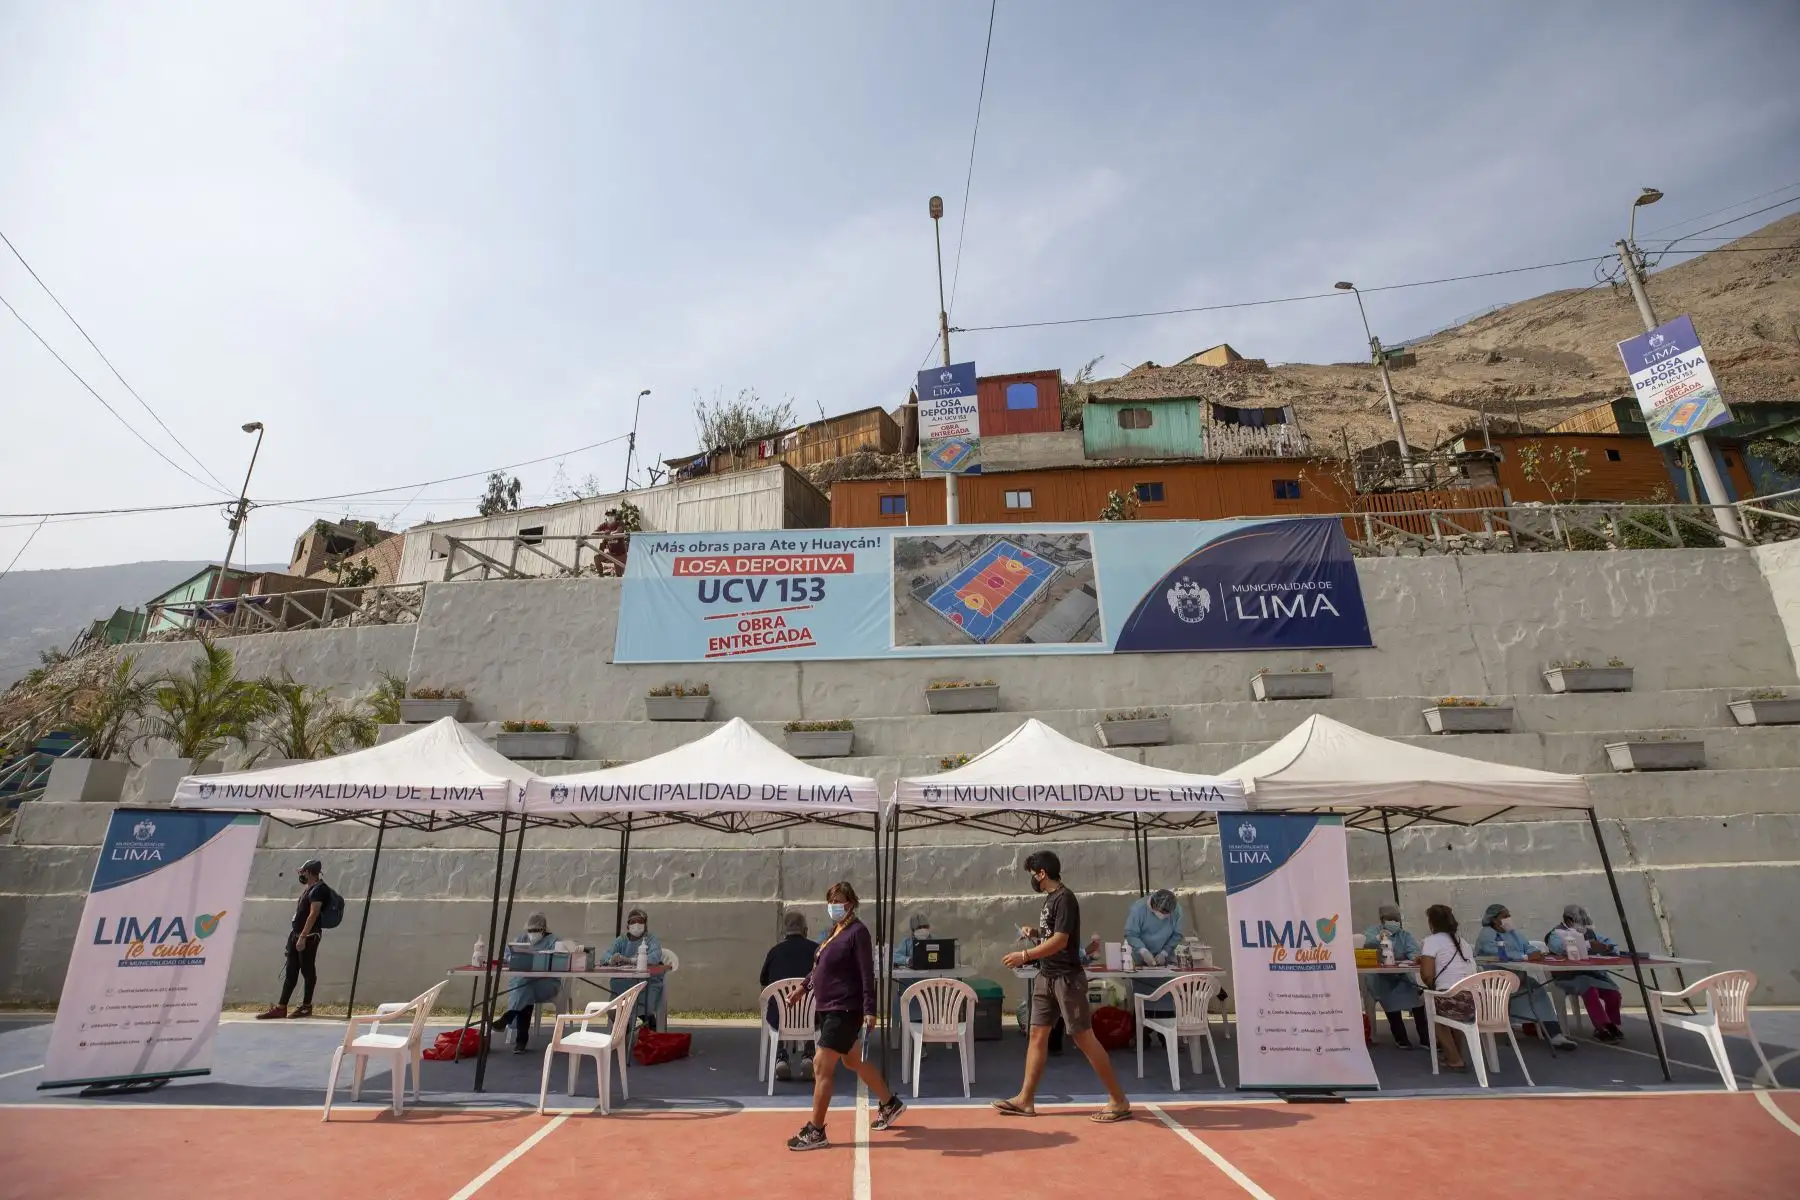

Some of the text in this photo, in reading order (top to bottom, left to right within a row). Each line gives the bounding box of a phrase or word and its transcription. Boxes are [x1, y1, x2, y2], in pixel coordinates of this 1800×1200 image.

[1644, 345, 1680, 365] LIMA
[1635, 357, 1705, 390] DEPORTIVA
[1650, 357, 1683, 375] LOSA
[933, 386, 962, 397] LIMA
[1654, 382, 1701, 407] ENTREGADA
[1664, 382, 1688, 396] OBRA
[921, 405, 977, 417] DEPORTIVA
[935, 399, 961, 408] LOSA
[930, 427, 970, 438] ENTREGADA
[940, 423, 960, 431] OBRA
[650, 536, 881, 555] ¡Más obras para Ate y Huaycán!
[679, 557, 848, 574] LOSA DEPORTIVA
[698, 577, 826, 604] UCV 153
[1232, 580, 1333, 593] MUNICIPALIDAD DE
[1235, 593, 1340, 620] LIMA
[737, 616, 787, 633] OBRA
[709, 627, 813, 651] ENTREGADA
[225, 784, 484, 801] MUNICIPALIDAD DE LIMA
[580, 783, 853, 803] MUNICIPALIDAD DE LIMA
[954, 784, 1225, 802] MUNICIPALIDAD DE LIMA
[111, 849, 163, 861] LIMA
[1229, 852, 1272, 864] LIMA
[93, 917, 188, 945] LIMA
[1239, 920, 1317, 948] LIMA
[152, 938, 205, 958] cuida
[1295, 942, 1331, 963] cuida
